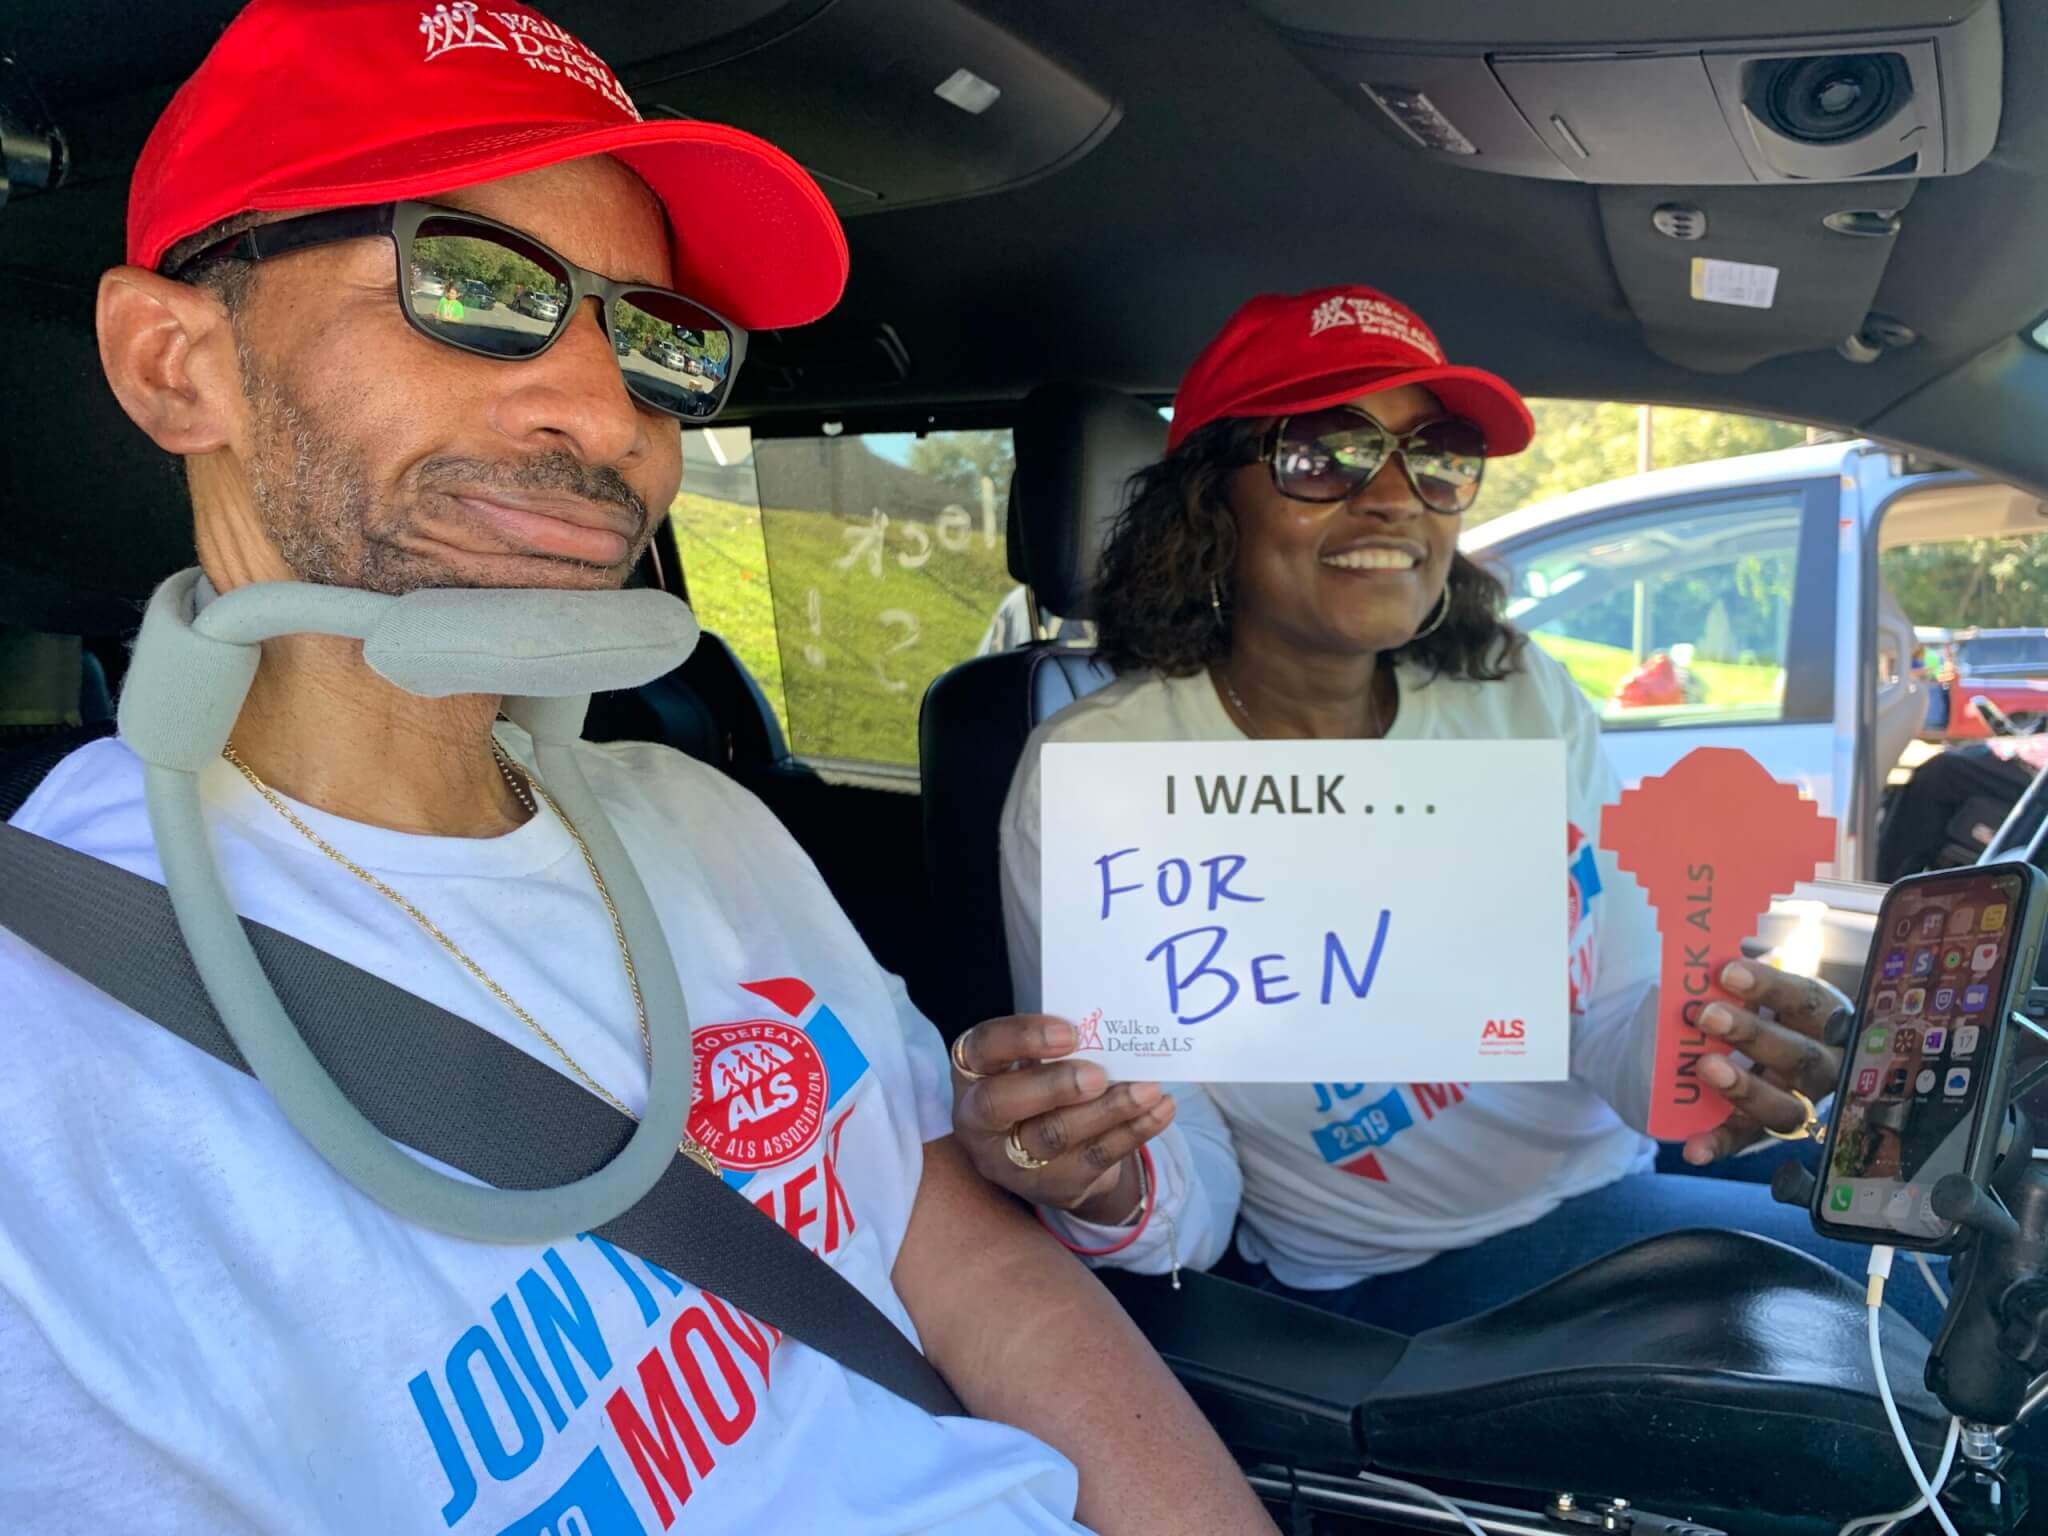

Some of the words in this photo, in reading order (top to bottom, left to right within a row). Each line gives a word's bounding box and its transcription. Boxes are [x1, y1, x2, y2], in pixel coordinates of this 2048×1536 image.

[487, 10, 579, 49] Walk
[509, 32, 612, 88] Defeat
[1166, 775, 1175, 814] I
[1195, 775, 1346, 814] WALK
[1094, 847, 1265, 920] FOR
[1685, 863, 1714, 932] ALS
[1145, 909, 1391, 1025] BEN
[696, 1036, 721, 1052] TO
[722, 1027, 804, 1048] DEFEAT
[1103, 1019, 1142, 1035] Walk
[1146, 1023, 1160, 1035] to
[1107, 1036, 1156, 1052] Defeat
[1158, 1037, 1195, 1052] ALS
[1481, 1018, 1525, 1039] ALS
[1673, 943, 1711, 1105] UNLOCK
[695, 1119, 725, 1150] THE
[725, 1137, 757, 1159] ALS
[763, 1071, 821, 1157] ASSOCIATION
[728, 1072, 799, 1133] ALS
[407, 1247, 613, 1528] JOIN
